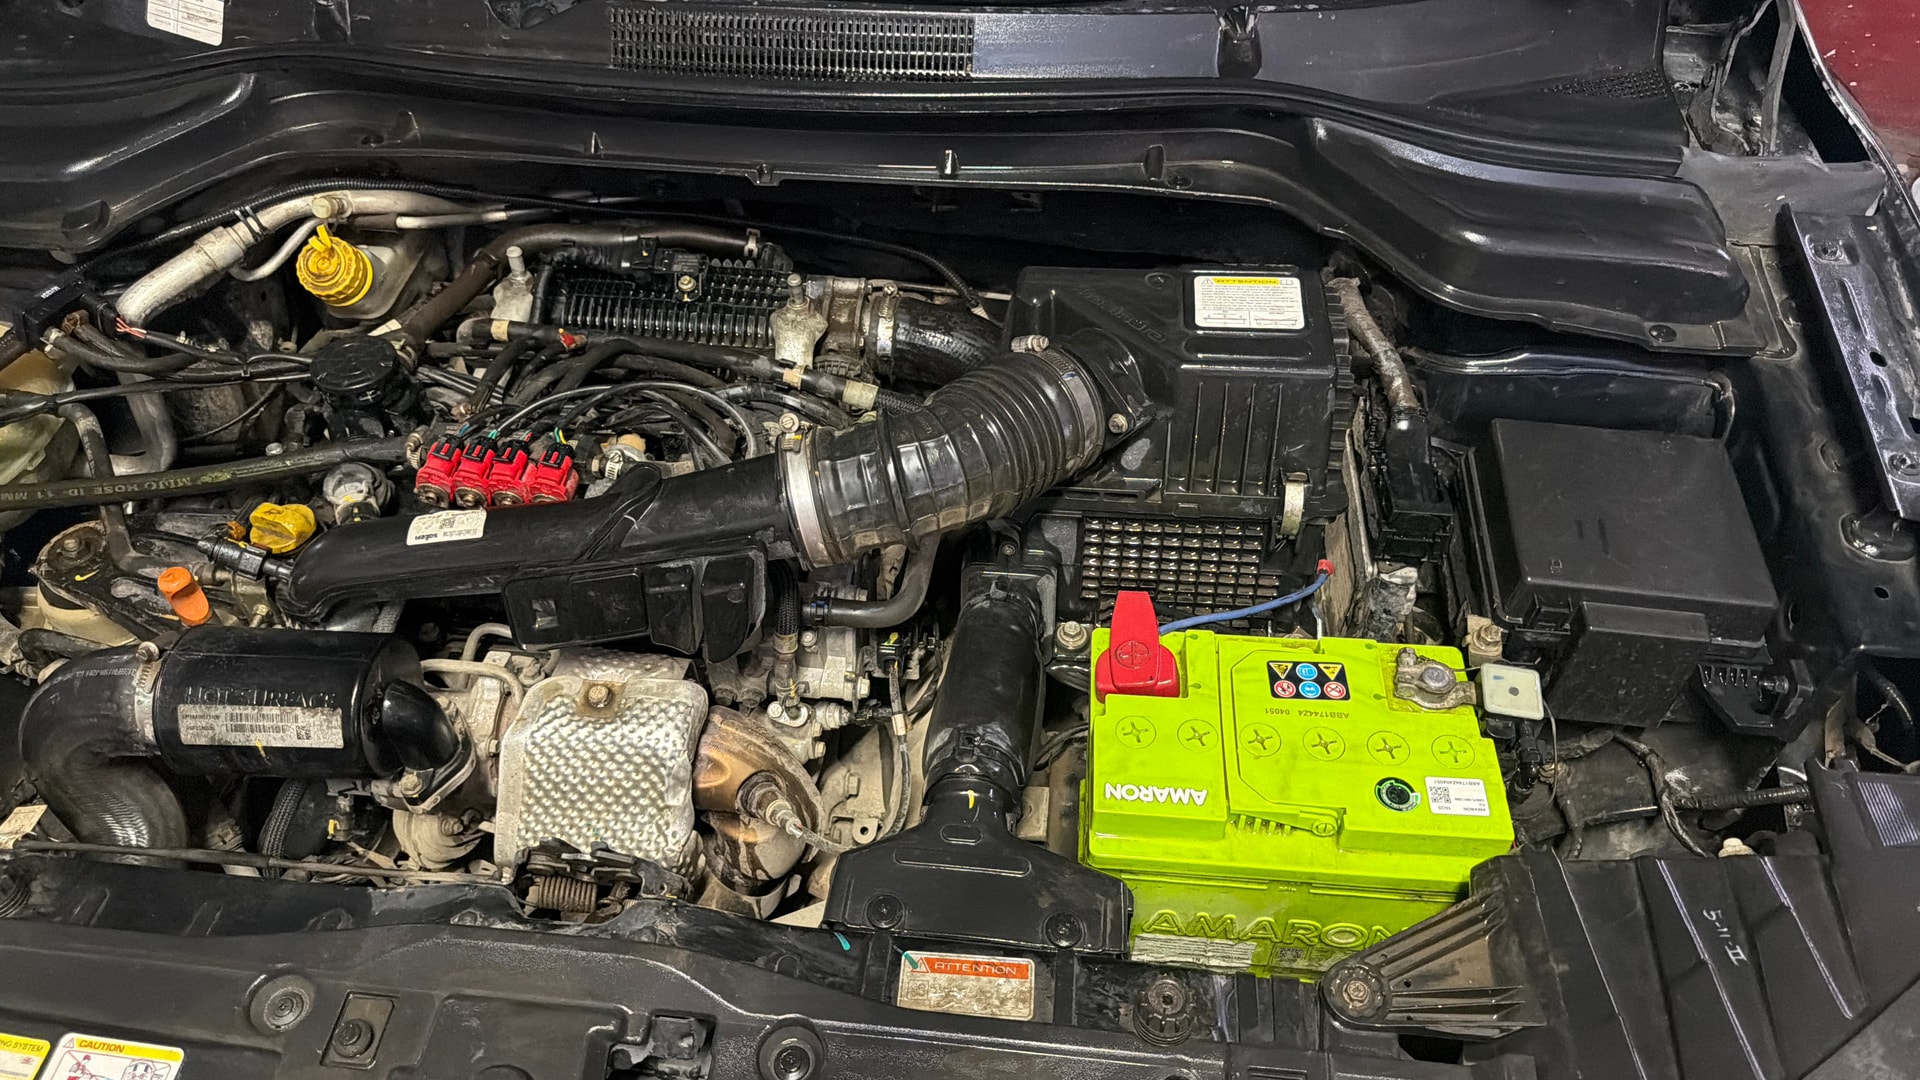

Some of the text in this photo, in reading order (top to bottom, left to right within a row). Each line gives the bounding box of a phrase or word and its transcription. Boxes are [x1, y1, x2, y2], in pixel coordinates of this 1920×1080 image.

[93, 483, 139, 495] HOSE
[185, 686, 234, 706] HOT
[1105, 782, 1208, 806] AMARON
[934, 962, 1017, 975] ATTENTION
[12, 1041, 44, 1052] SYSTEM
[78, 1039, 125, 1053] CAUTION
